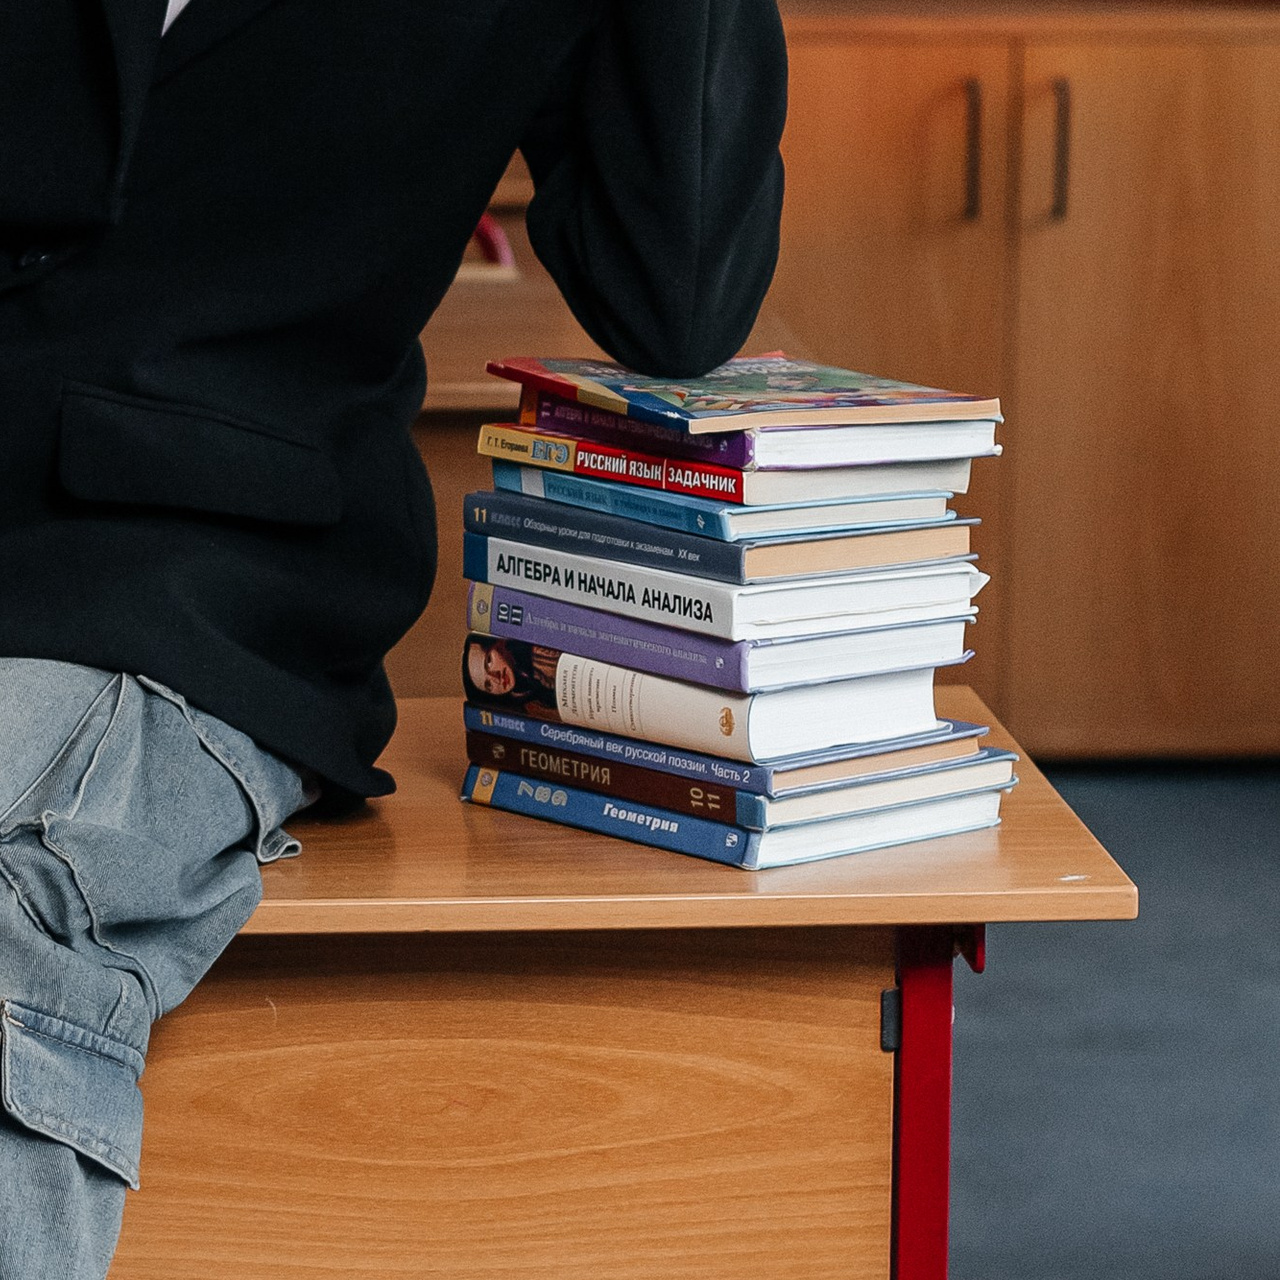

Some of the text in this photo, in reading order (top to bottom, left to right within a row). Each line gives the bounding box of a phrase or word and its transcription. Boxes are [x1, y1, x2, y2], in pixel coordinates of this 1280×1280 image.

[531, 440, 570, 465] ЕГЭ
[576, 450, 737, 494] РУССКИЙ ЯЗЫК ЗАДАЧНИК
[473, 507, 487, 523] 11
[523, 517, 558, 534] Обзорные
[558, 527, 578, 537] уроки
[578, 530, 591, 539] для
[592, 533, 630, 548] подготовки
[688, 553, 701, 562] век
[496, 553, 714, 624] АЛГЕБРА И НАЧАЛА АНАЛИЗА
[498, 603, 523, 625] 10 11
[480, 710, 751, 784] 11 класс Серебряный век русской поэзии. Часть 2
[520, 748, 611, 785] ГЕОМЕТРИЯ
[517, 780, 534, 797] 7
[534, 785, 552, 804] 8
[689, 786, 721, 810] 10 11
[603, 803, 679, 833] Геометрия
